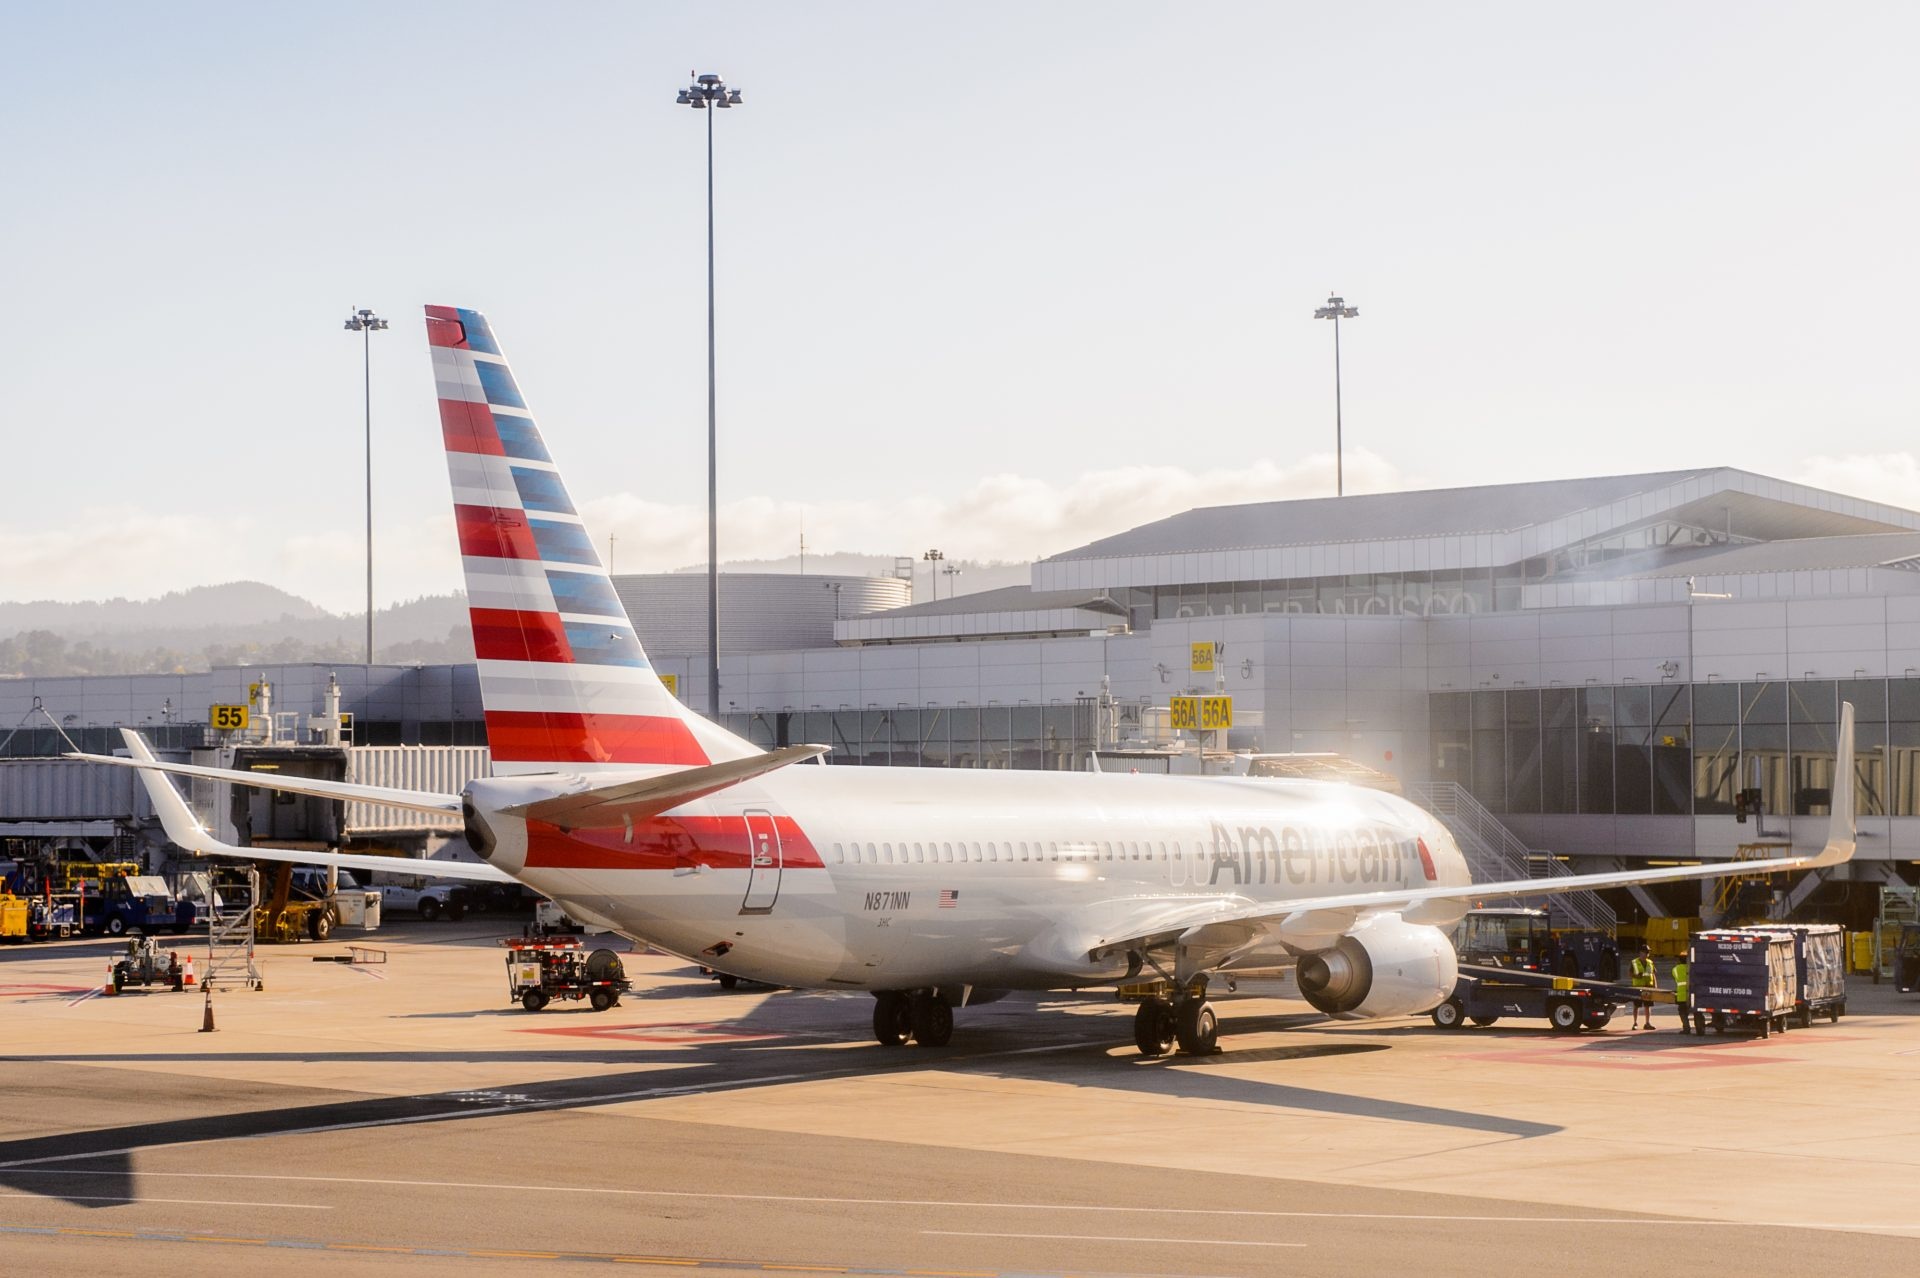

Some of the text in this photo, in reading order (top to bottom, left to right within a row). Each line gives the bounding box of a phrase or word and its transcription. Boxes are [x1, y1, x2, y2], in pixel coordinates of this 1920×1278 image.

[1192, 649, 1213, 664] 56A
[217, 707, 242, 727] 55
[1173, 700, 1196, 726] 56A
[1203, 699, 1229, 727] 56A
[1208, 820, 1402, 885] American
[864, 891, 911, 911] N871NN
